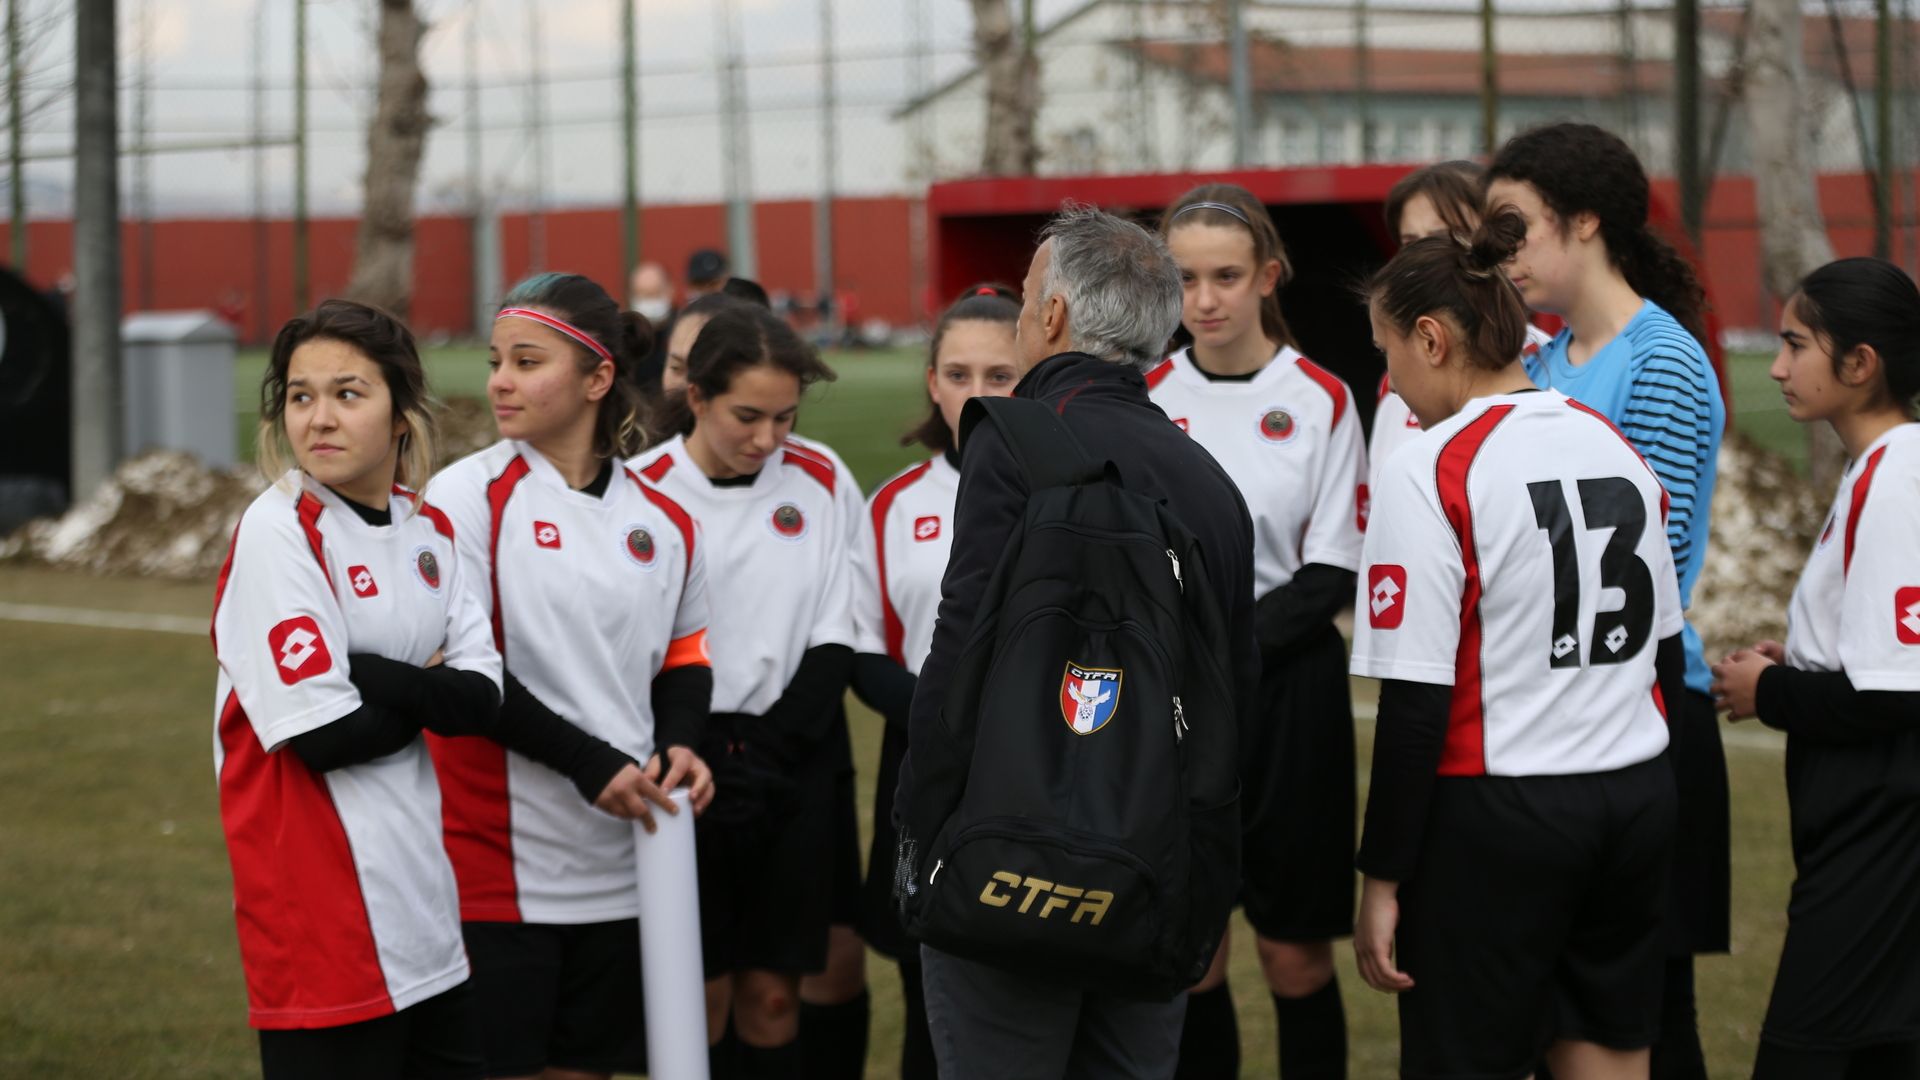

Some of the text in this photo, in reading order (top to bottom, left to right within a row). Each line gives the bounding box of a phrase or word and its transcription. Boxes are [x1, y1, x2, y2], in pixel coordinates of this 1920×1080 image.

[1526, 476, 1655, 670] 13
[1071, 668, 1117, 681] CTFA
[979, 870, 1114, 926] CTFA
